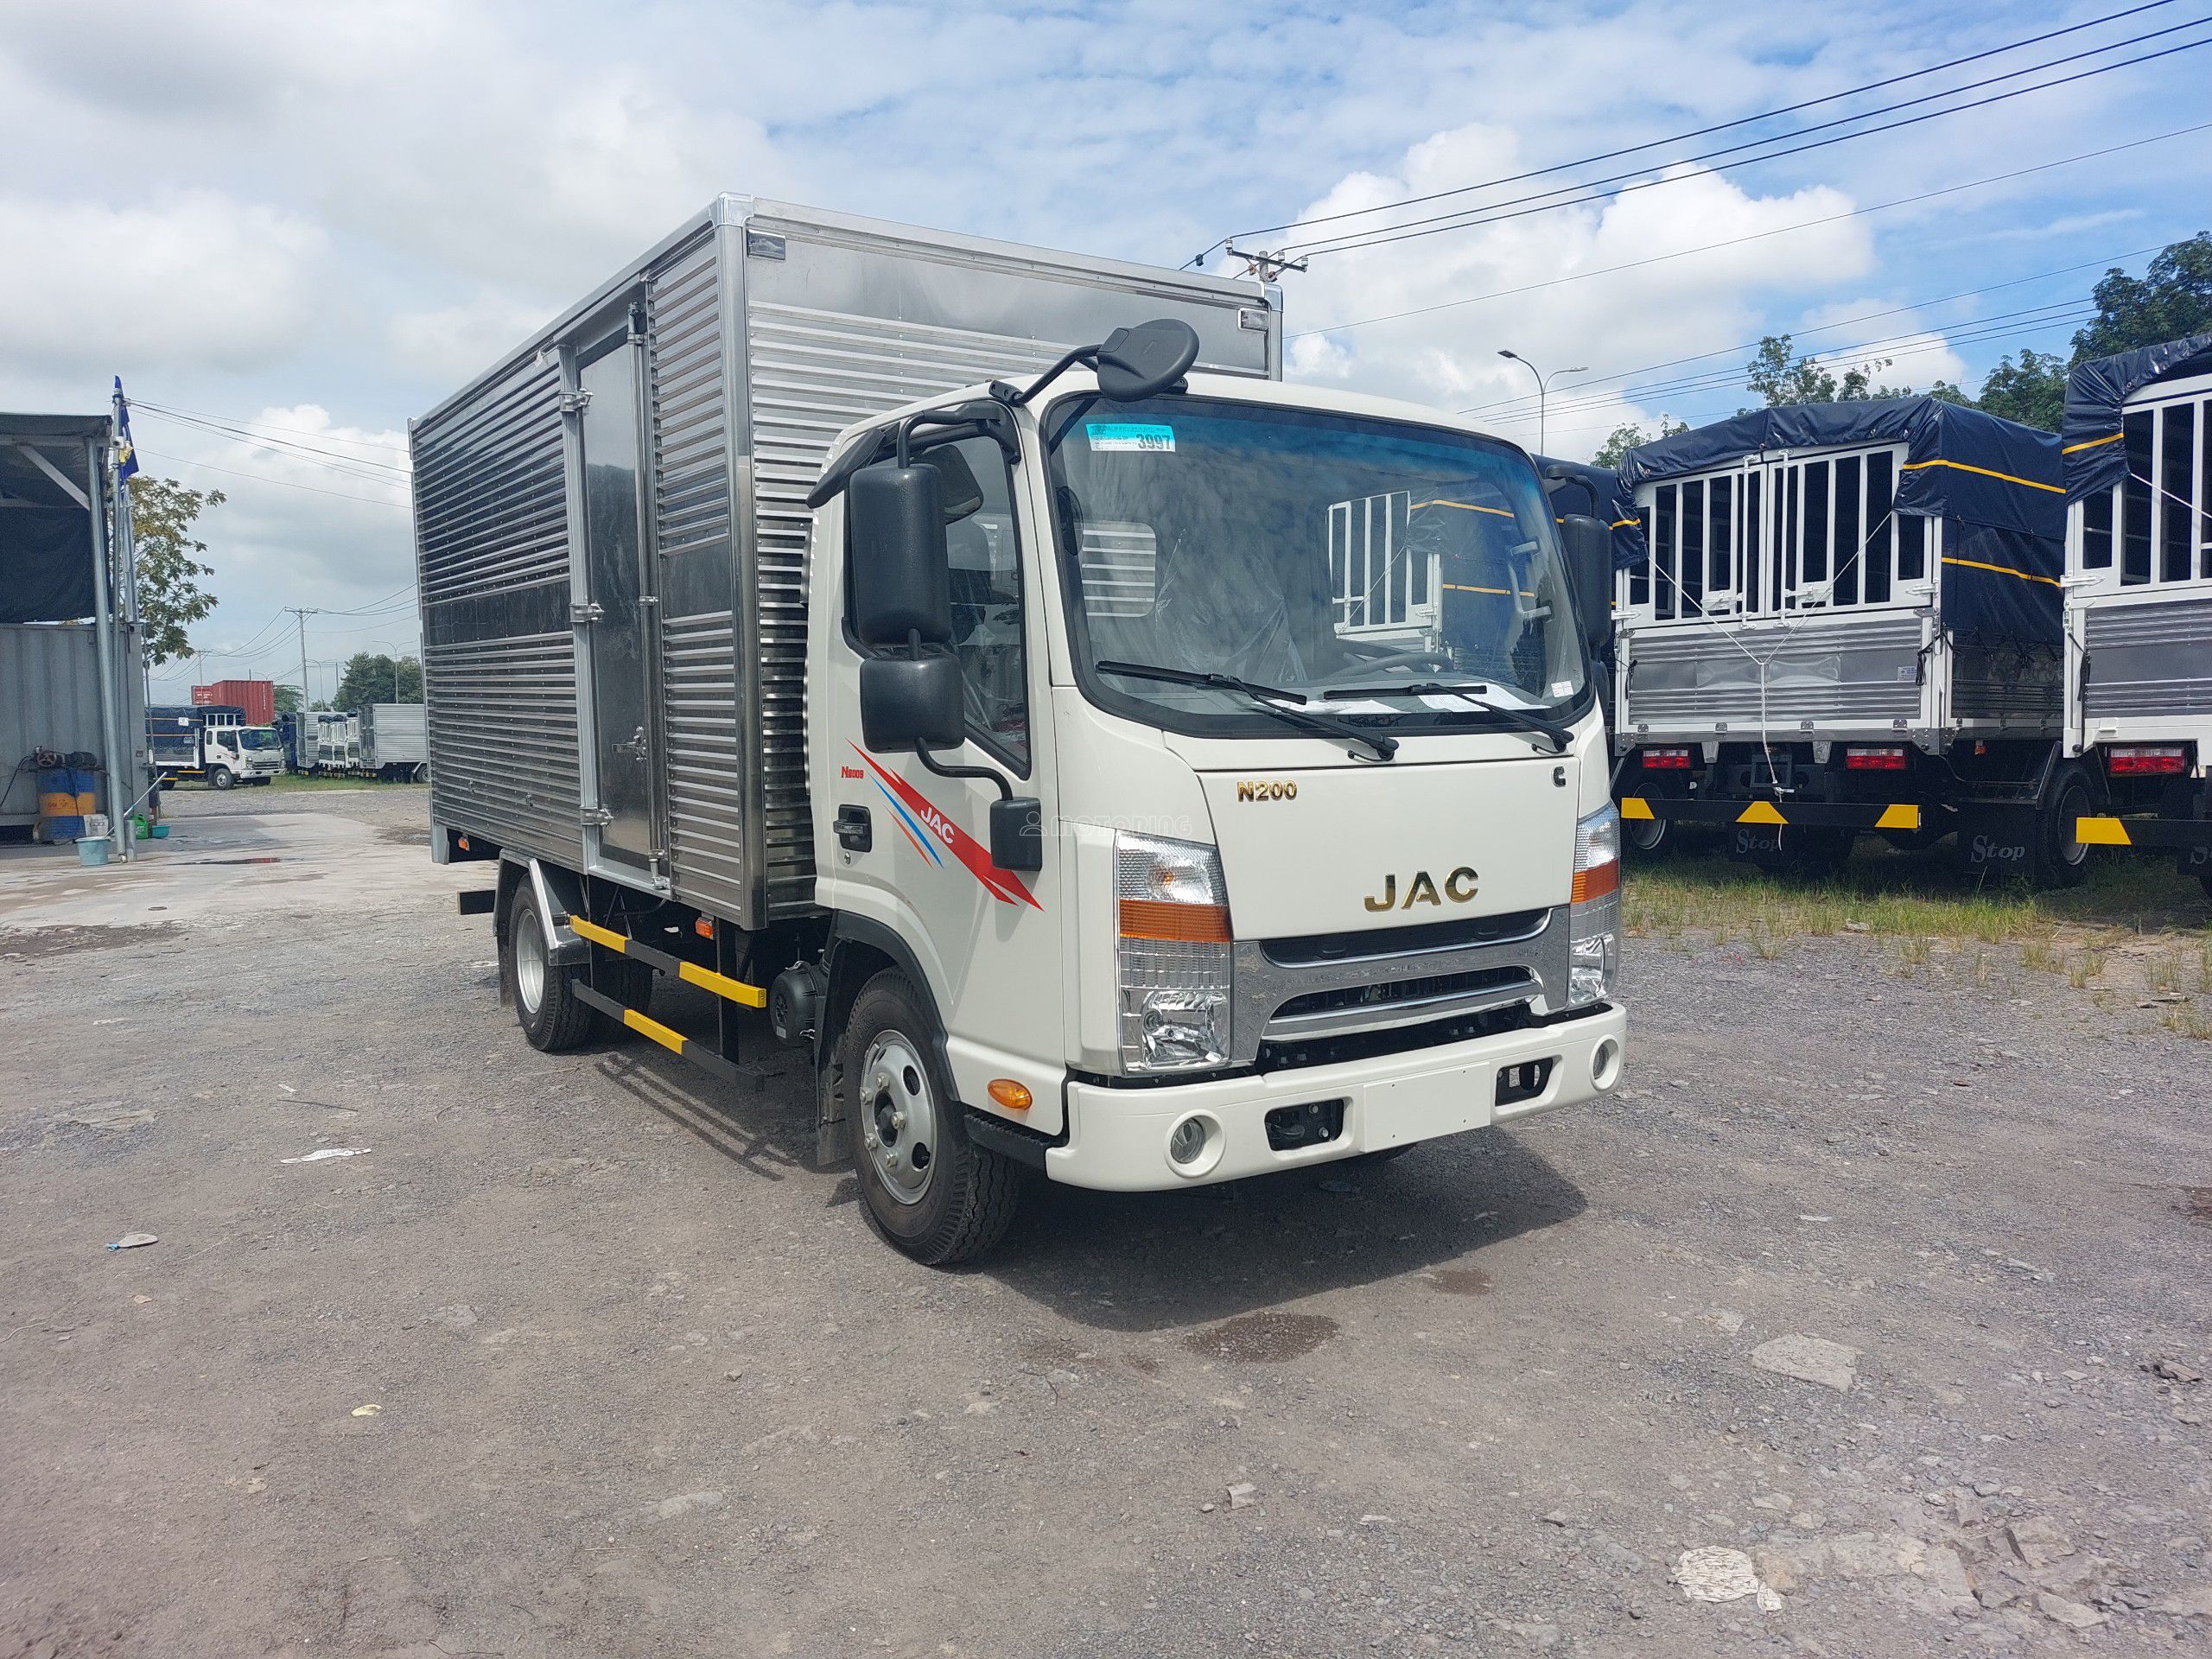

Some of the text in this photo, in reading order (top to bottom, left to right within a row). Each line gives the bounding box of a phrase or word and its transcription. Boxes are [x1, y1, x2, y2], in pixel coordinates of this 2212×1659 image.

[1136, 434, 1171, 449] 3997
[1236, 779, 1298, 802] N200
[920, 806, 955, 844] JAC
[1736, 829, 1782, 854] Stop
[1971, 835, 2025, 862] Stop
[1363, 867, 1478, 912] JAC
